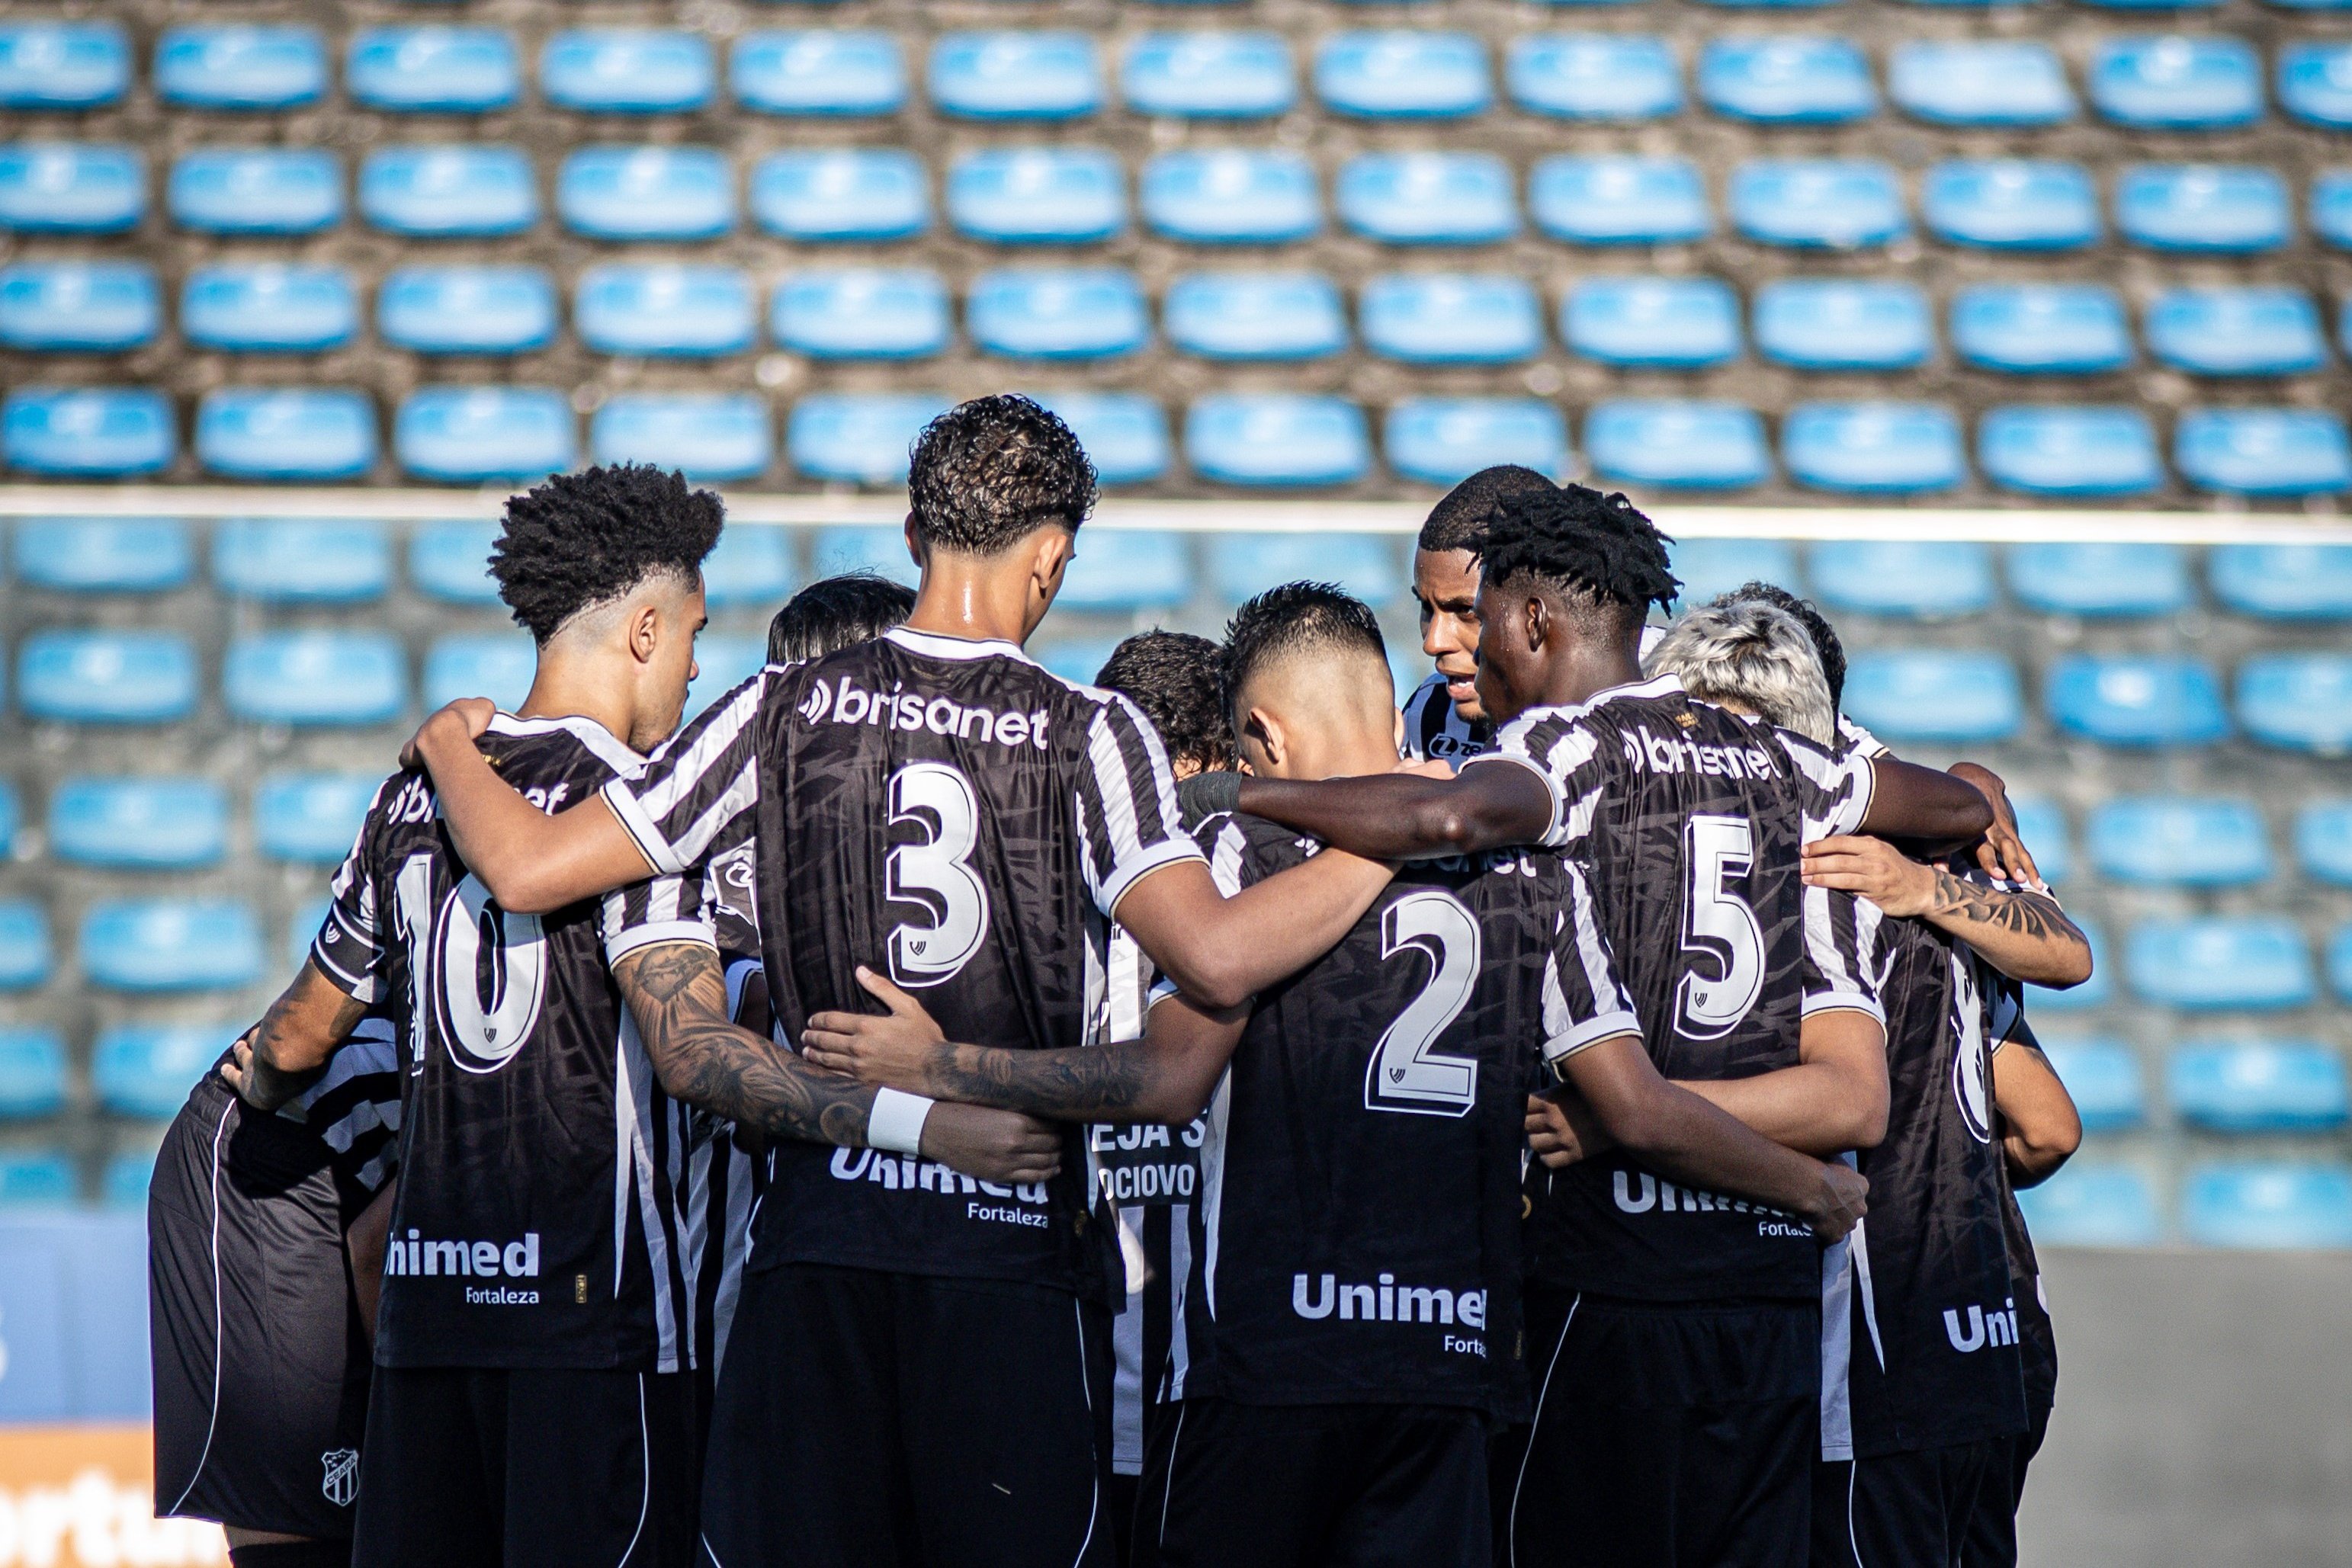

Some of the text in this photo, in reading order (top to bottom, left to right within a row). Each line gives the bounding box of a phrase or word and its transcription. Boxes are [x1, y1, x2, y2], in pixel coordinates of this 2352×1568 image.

[833, 676, 1049, 750] brisanet
[885, 762, 988, 987] 3
[1674, 815, 1766, 1041] 5
[393, 854, 547, 1075] 10
[1365, 890, 1481, 1117] 2
[967, 1202, 1048, 1229] Fortaleza
[384, 1229, 540, 1277] nimed
[466, 1287, 540, 1304] Fortaleza
[1292, 1273, 1487, 1332] Unime
[1943, 1297, 2020, 1353] Uni
